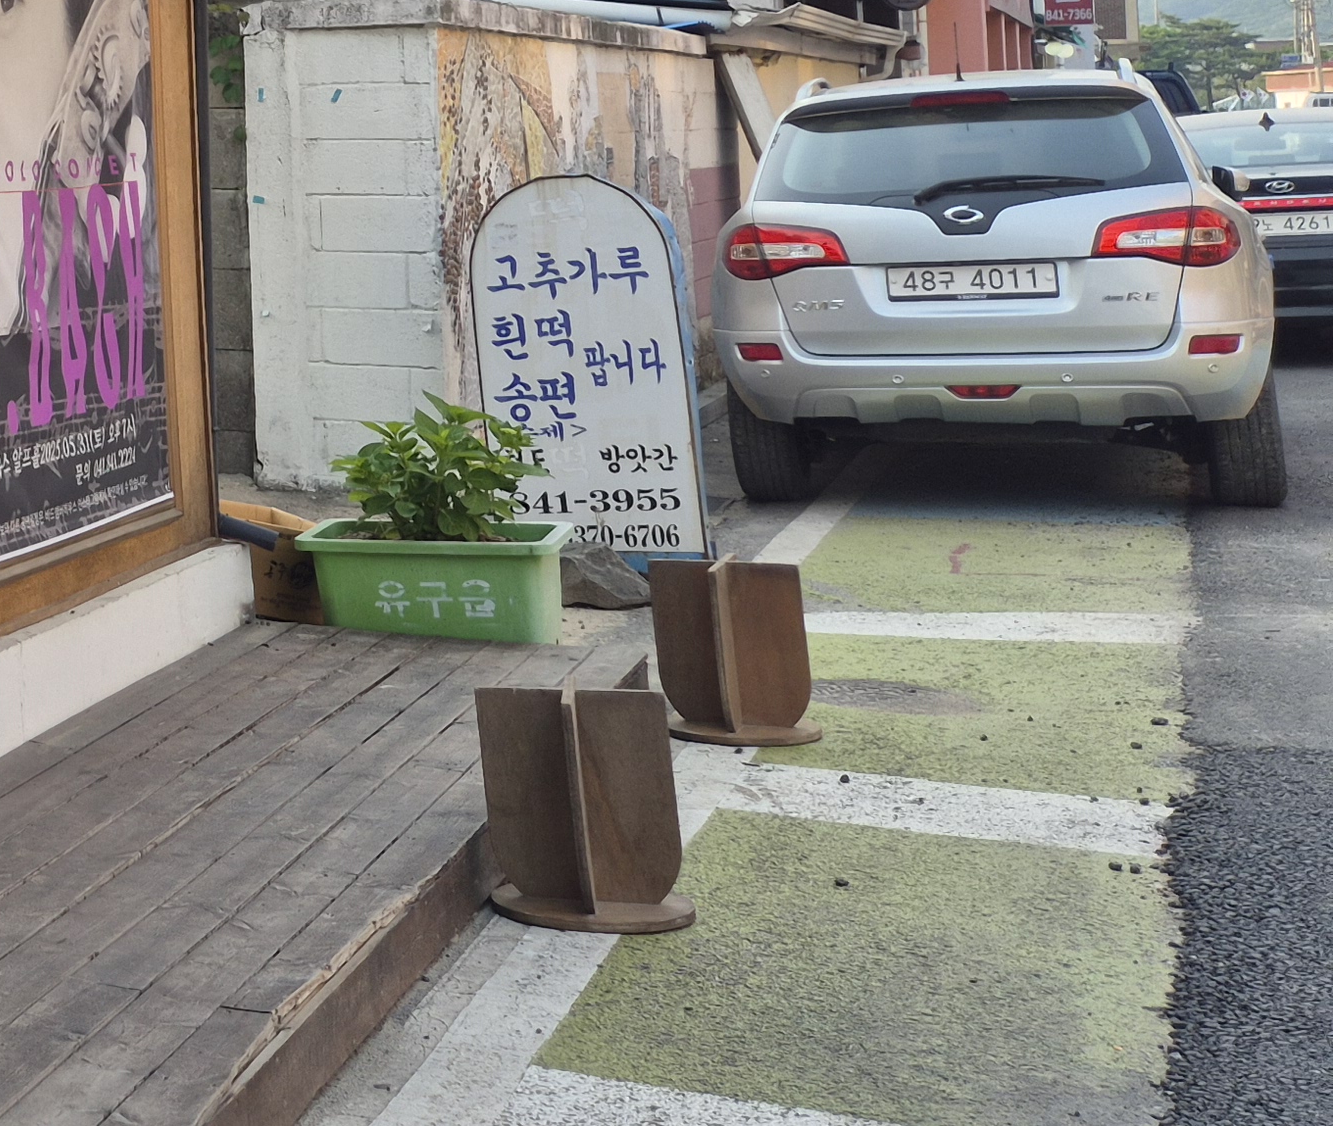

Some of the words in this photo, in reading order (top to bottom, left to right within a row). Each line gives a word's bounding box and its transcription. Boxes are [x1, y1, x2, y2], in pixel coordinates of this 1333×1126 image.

[1046, 8, 1093, 22] 841-7366
[1283, 215, 1331, 231] 4261
[487, 246, 650, 295] 고추가루
[902, 271, 955, 292] 48구
[969, 266, 1040, 290] 4011
[792, 299, 845, 312] QM5
[584, 338, 668, 387] 팝니다
[494, 371, 578, 422] 송편
[599, 443, 679, 474] 방앗간
[75, 461, 92, 486] 문의
